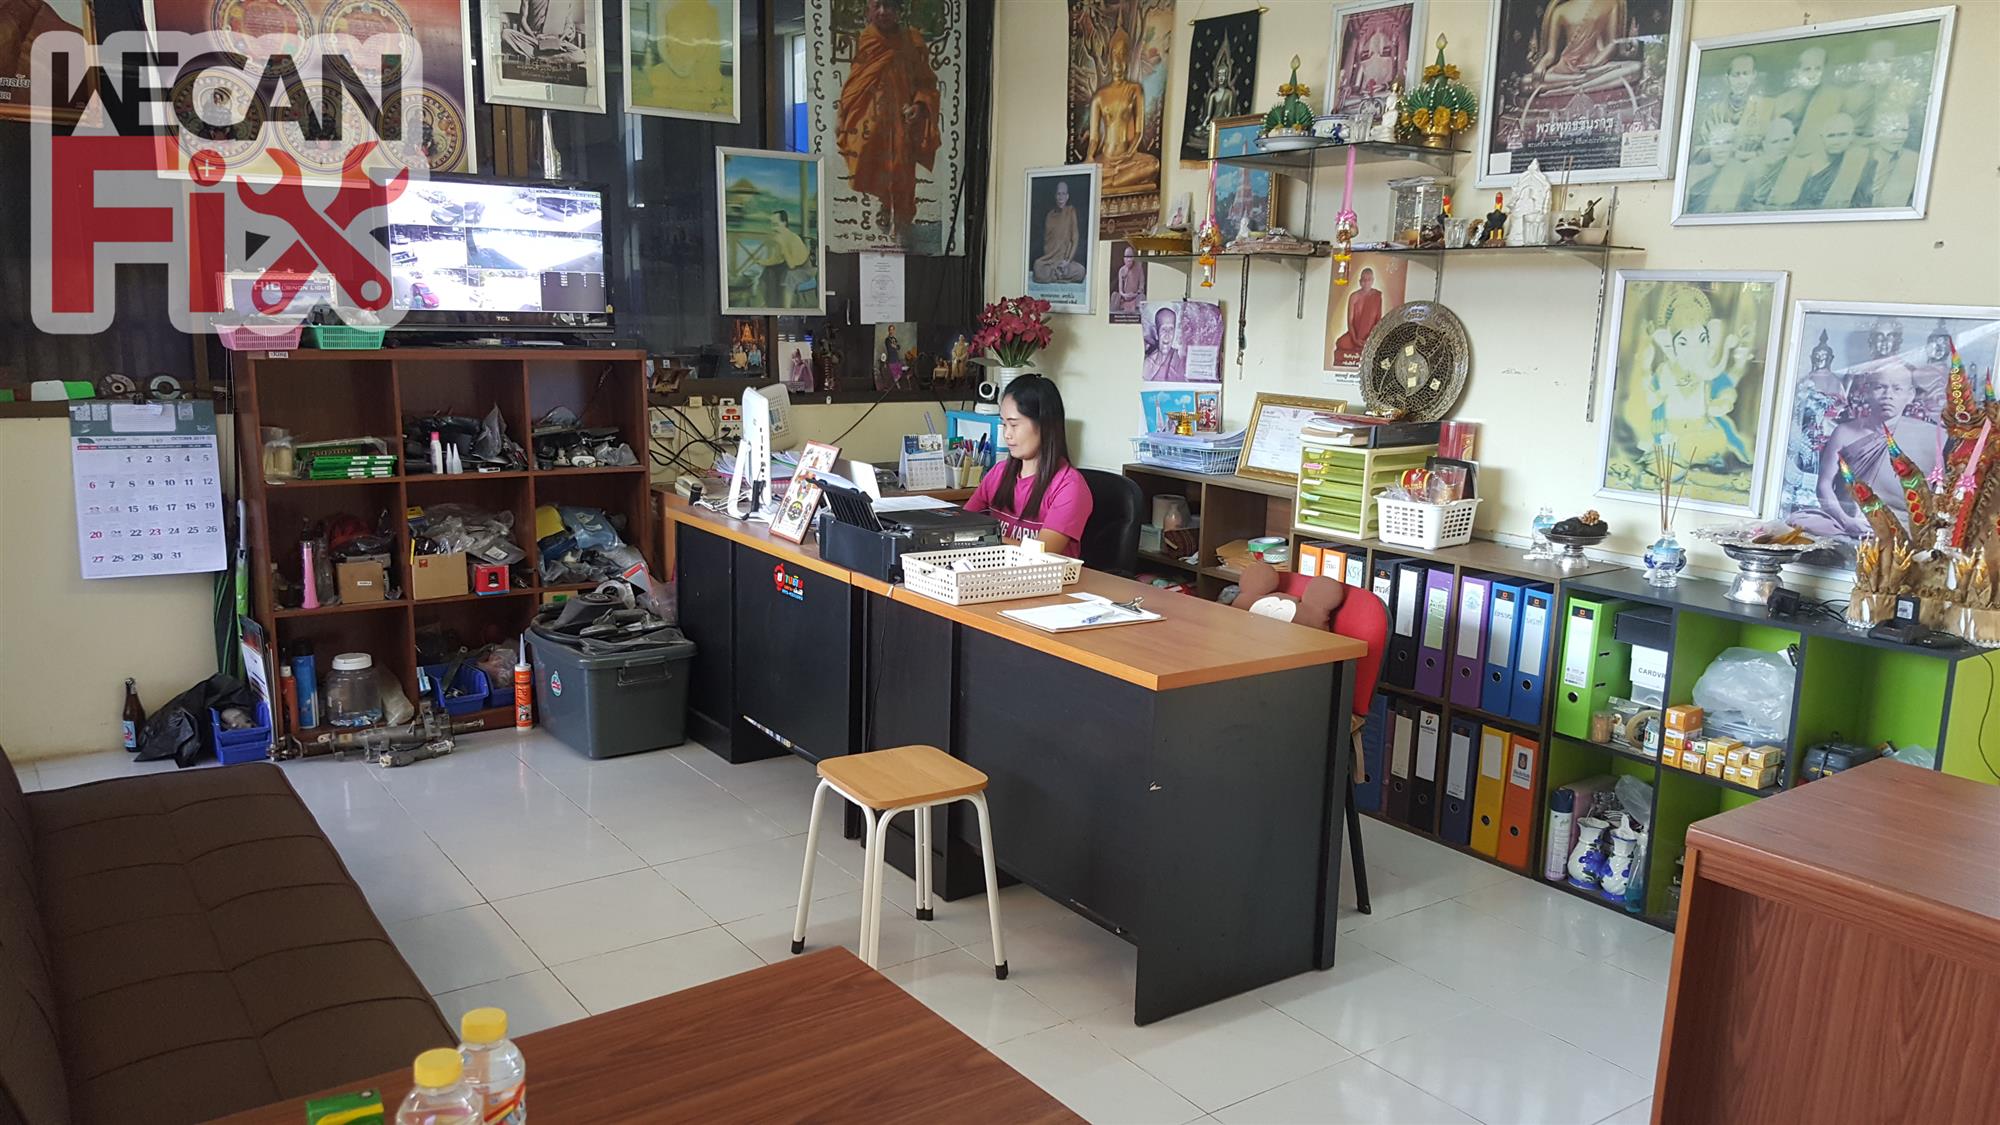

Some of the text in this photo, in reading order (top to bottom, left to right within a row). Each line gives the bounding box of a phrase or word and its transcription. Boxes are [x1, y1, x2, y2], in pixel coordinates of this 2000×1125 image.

[145, 456, 153, 464] 2
[108, 480, 116, 489] 7
[166, 504, 177, 512] 17
[185, 502, 197, 511] 18
[204, 502, 216, 510] 19
[89, 530, 103, 539] 20
[91, 556, 105, 564] 27
[111, 554, 125, 563] 28
[131, 554, 144, 562] 29
[150, 552, 164, 561] 30
